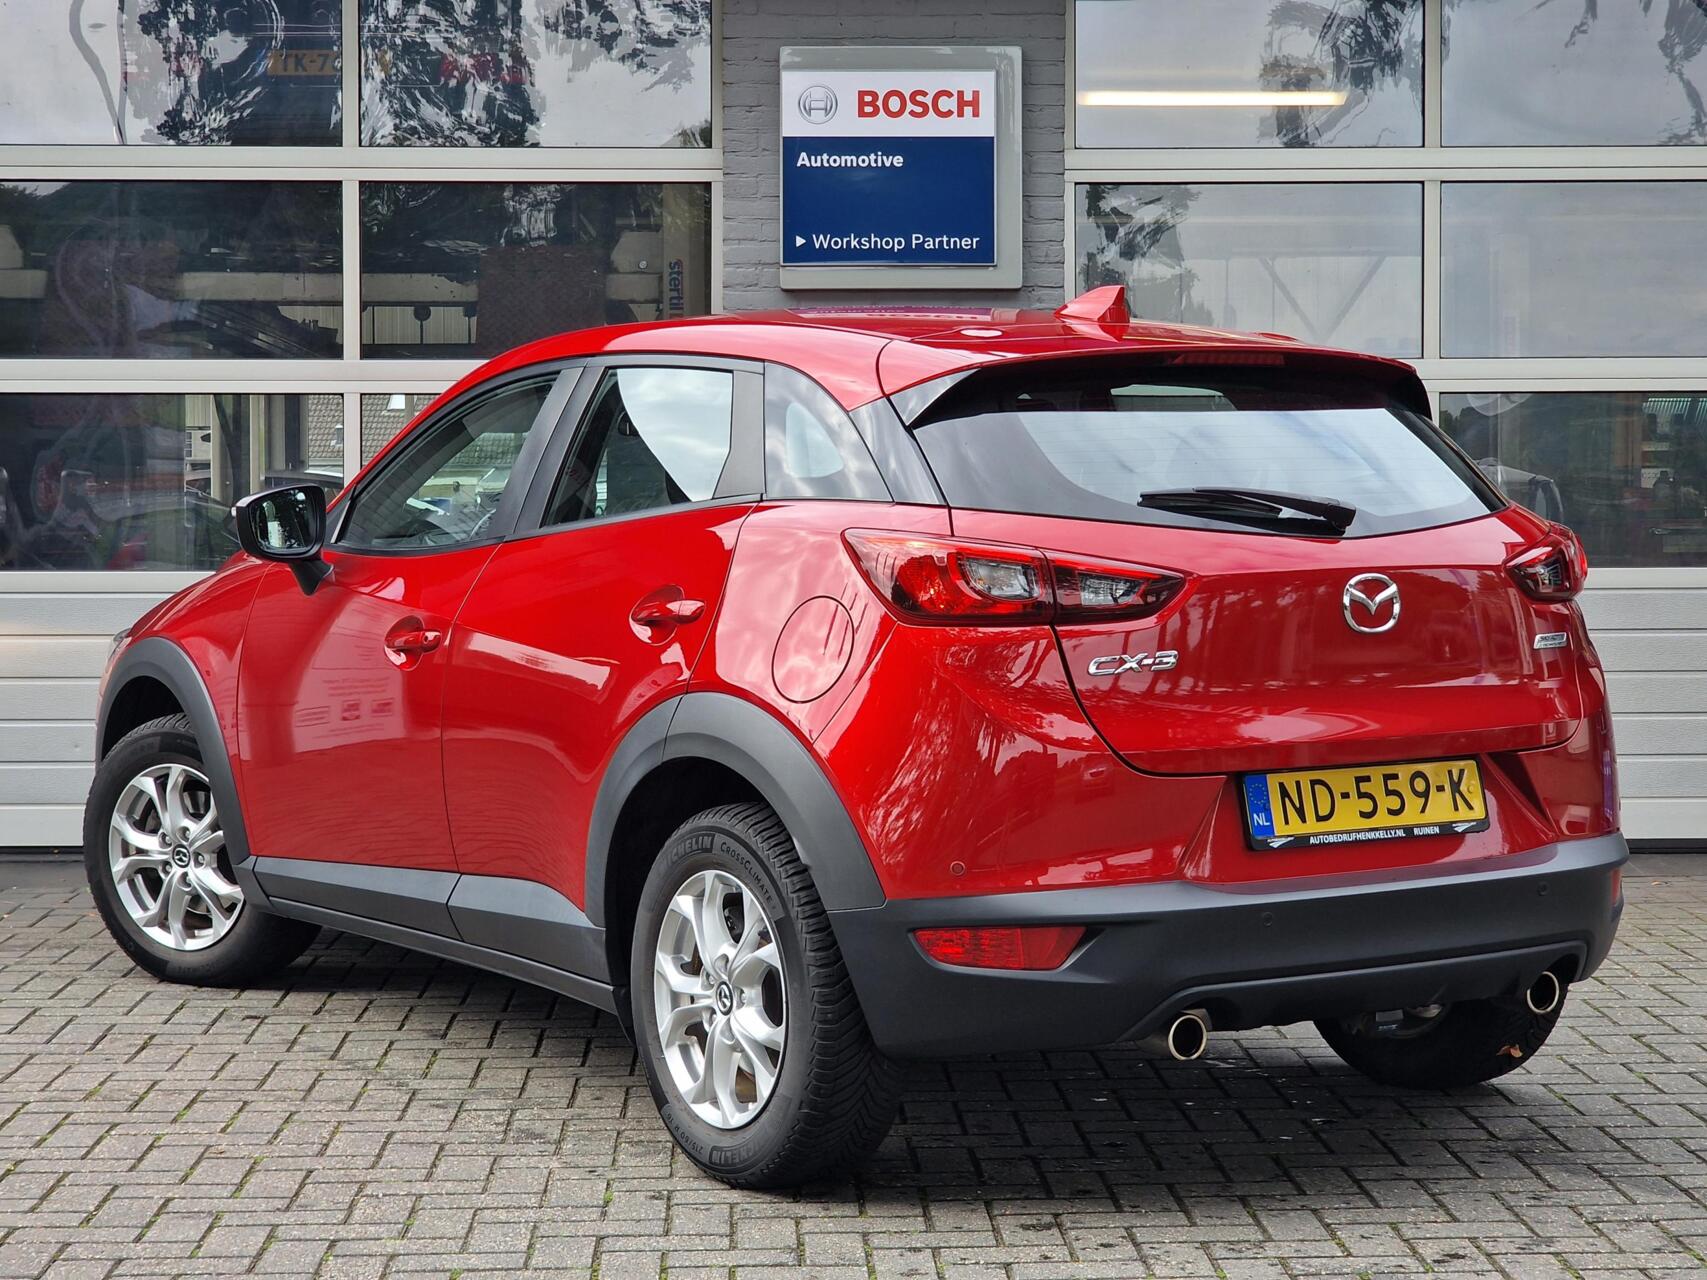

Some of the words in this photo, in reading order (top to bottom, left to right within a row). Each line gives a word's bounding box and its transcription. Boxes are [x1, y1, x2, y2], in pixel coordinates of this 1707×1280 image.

[857, 89, 981, 119] BOSCH
[796, 152, 904, 168] Automotive
[812, 233, 905, 252] Workshop
[911, 234, 980, 250] Partner
[669, 260, 684, 310] stertil
[1087, 650, 1178, 676] CX-3
[1278, 768, 1475, 826] ND-559-K
[1253, 812, 1271, 826] NL
[1413, 826, 1440, 836] RUINEN
